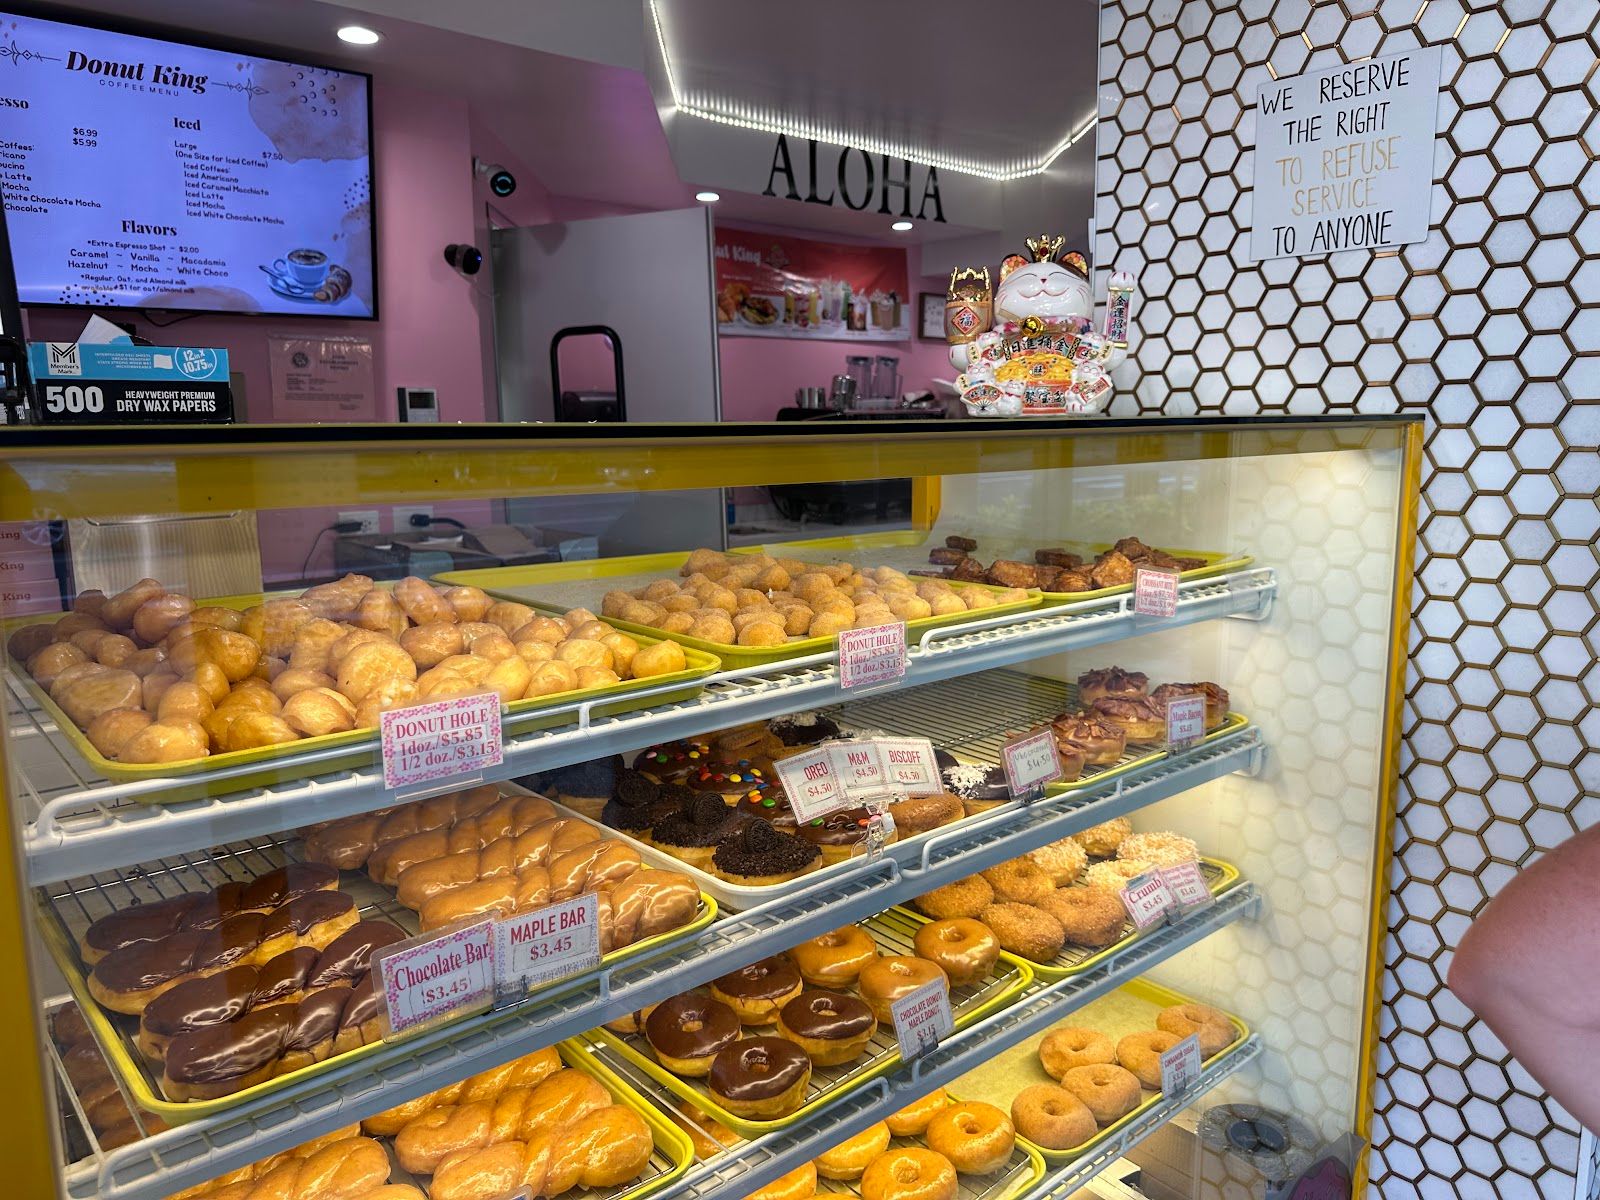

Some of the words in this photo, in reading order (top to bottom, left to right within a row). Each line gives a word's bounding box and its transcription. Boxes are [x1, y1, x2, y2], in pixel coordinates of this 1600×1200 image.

[65, 50, 144, 81] Donut
[152, 64, 208, 94] King
[100, 79, 145, 91] COFFEE
[150, 87, 179, 97] MENU
[1261, 87, 1294, 116] WE
[1319, 57, 1410, 104] RESERVE
[174, 117, 201, 131] Iced
[1283, 115, 1322, 146] THE
[1336, 101, 1391, 137] RIGHT
[73, 127, 98, 138] $6.99
[73, 138, 97, 148] $5.99
[174, 140, 197, 151] Large
[175, 150, 193, 159] (One
[194, 152, 210, 161] Size
[212, 154, 223, 162] for
[225, 156, 240, 165] Iced
[241, 158, 269, 169] Coffee)
[262, 151, 283, 161] $7.50
[1275, 156, 1303, 187] TO
[1322, 135, 1402, 181] REFUSE
[183, 161, 199, 171] Iced
[5, 171, 32, 181] Latte
[184, 170, 199, 179] Iced
[200, 172, 239, 184] Americano
[762, 133, 947, 223] ALOHA
[2, 181, 30, 192] Mocha
[185, 180, 200, 189] Iced
[201, 182, 232, 192] Caramel
[3, 192, 28, 202] White
[30, 194, 73, 206] Chocolate
[75, 199, 101, 209] Mocha
[185, 190, 200, 198] Iced
[201, 191, 224, 201] Latte
[1291, 177, 1378, 217] SERVICE
[4, 202, 48, 214] Chocolate
[186, 199, 201, 208] Iced
[202, 201, 226, 210] Mocha
[186, 209, 201, 217] Iced
[203, 211, 224, 220] White
[225, 212, 261, 223] Chocolate
[262, 216, 285, 225] Mocha
[121, 220, 178, 237] Flavors
[1272, 226, 1296, 256] TO
[1310, 210, 1394, 252] ANYONE
[115, 241, 148, 251] Espresso
[149, 243, 166, 252] Shot
[178, 245, 200, 254] $2.00
[70, 248, 109, 259] Caramel
[130, 252, 160, 263] Vanilla
[181, 256, 226, 267] Macadamia
[67, 260, 109, 271] Hazelnut
[131, 263, 159, 273] Mocha
[177, 266, 202, 276] White
[203, 268, 229, 278] Choco
[46, 385, 104, 413] 500
[125, 390, 179, 400] HEAVYWEIGHT
[180, 391, 216, 400] PREMIUM
[116, 399, 141, 412] DRY
[142, 399, 170, 412] WAX
[172, 399, 216, 412] PAPERS
[847, 636, 874, 653] DONUT
[876, 632, 898, 648] HOLE
[850, 664, 861, 676] 1/2
[395, 715, 447, 739] DONUT
[450, 708, 489, 730] HOLE
[401, 754, 421, 771] 1/2
[425, 740, 495, 767] doz./$3.15
[847, 751, 870, 766] M&M
[888, 750, 921, 764] BISCOFF
[803, 761, 829, 781] OREO
[855, 766, 878, 779] $4.50
[898, 770, 920, 781] $4.50
[807, 783, 832, 797] $4.50
[1128, 877, 1162, 904] Crumb
[1142, 894, 1163, 912] $3.45
[510, 914, 556, 945] MAPLE
[560, 906, 586, 930] BAR
[530, 935, 572, 961] $3.45
[394, 952, 462, 991] Chocolate
[464, 941, 489, 966] Bar
[426, 976, 469, 1003] $3.45
[900, 1000, 926, 1022] CHOCOLATE
[908, 1012, 925, 1030] MAPLE
